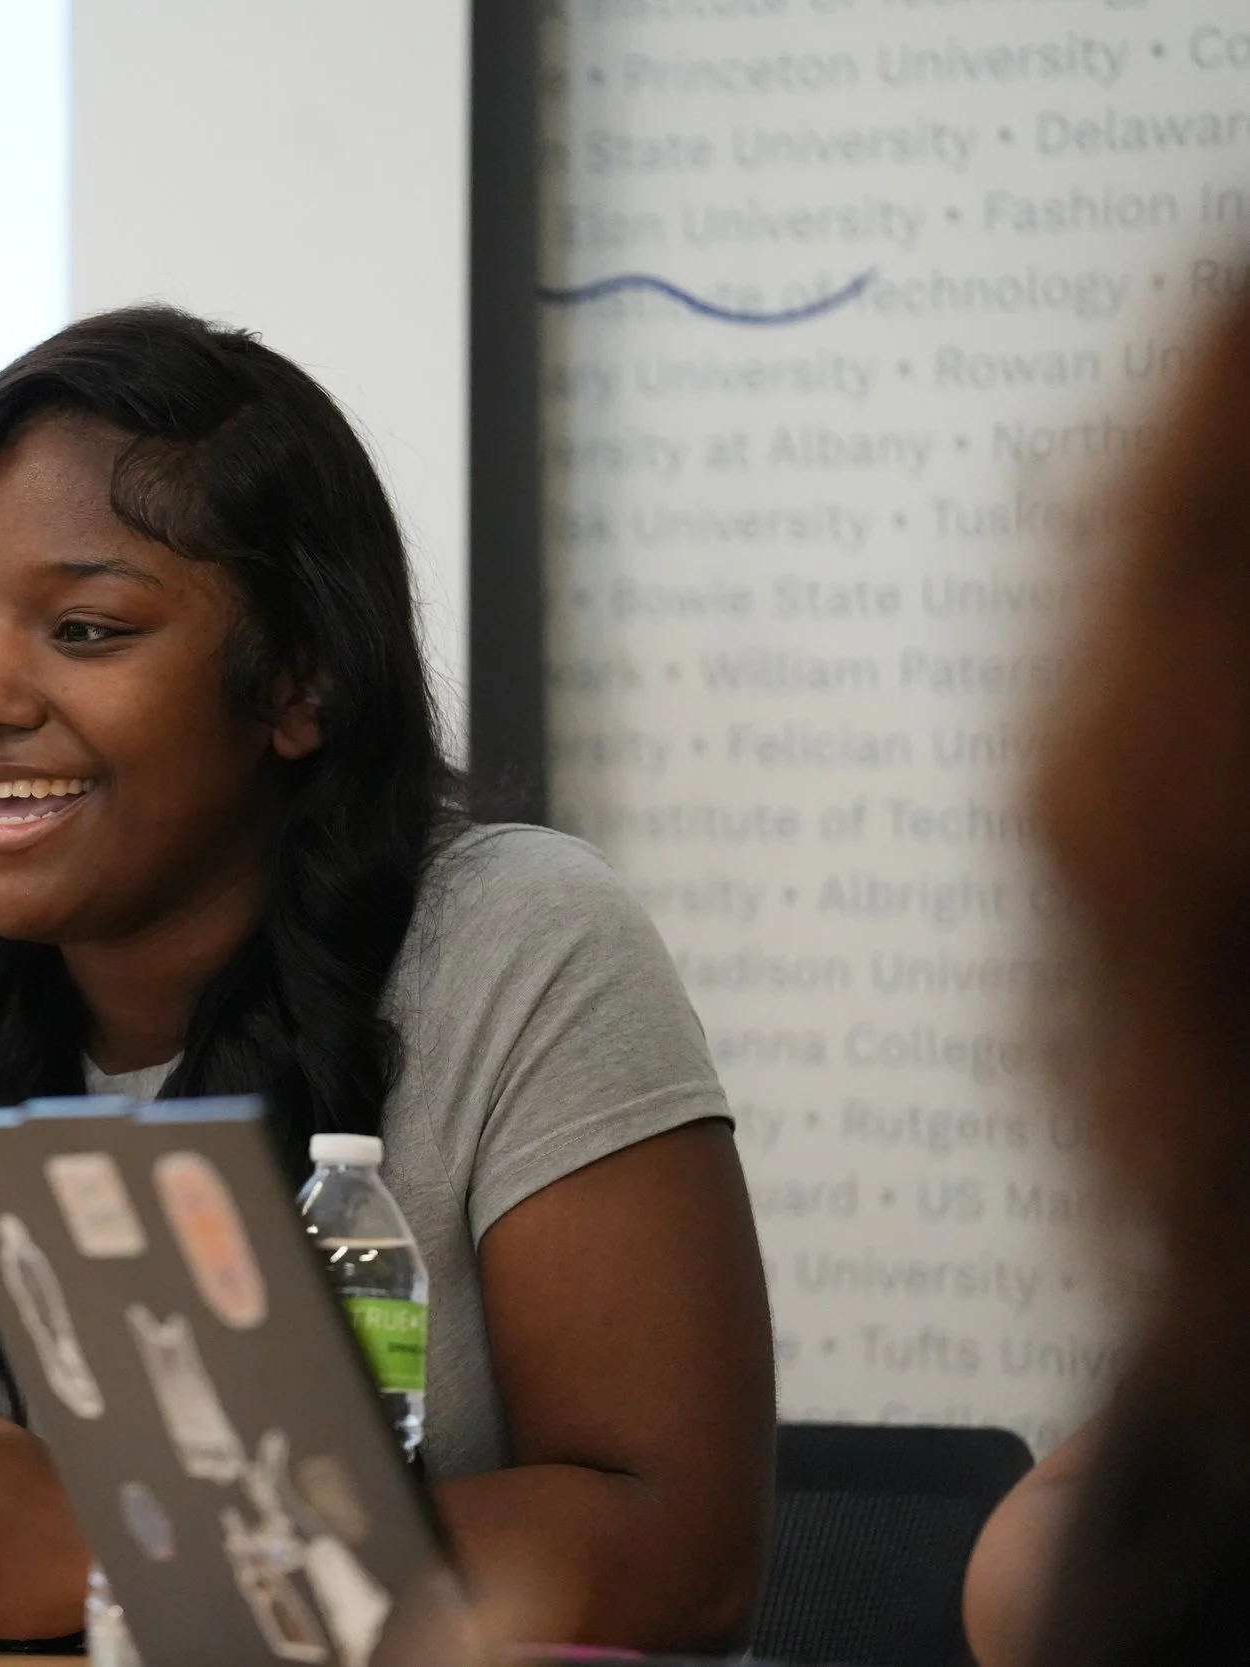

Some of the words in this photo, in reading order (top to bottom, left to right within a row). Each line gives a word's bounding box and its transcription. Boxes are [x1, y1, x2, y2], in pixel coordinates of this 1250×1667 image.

[622, 51, 859, 95] Princeton
[876, 35, 1130, 87] University
[584, 127, 717, 175] State
[731, 115, 981, 171] University
[682, 197, 928, 251] University
[983, 185, 1180, 235] Fashion
[636, 343, 878, 405] University
[934, 340, 1102, 392] Rowan
[704, 426, 751, 474] at
[767, 421, 938, 481] Albany
[631, 498, 875, 560] University
[610, 574, 756, 623] Bowie
[770, 572, 904, 622] State
[698, 643, 881, 696] William
[726, 716, 914, 767] Felician
[818, 794, 869, 843] of
[815, 873, 1008, 933] Albright
[843, 1020, 1026, 1087] College
[840, 1097, 1030, 1160] Rutgers
[917, 1175, 987, 1224] US
[792, 1244, 1042, 1314] University
[859, 1322, 983, 1377] Tufts
